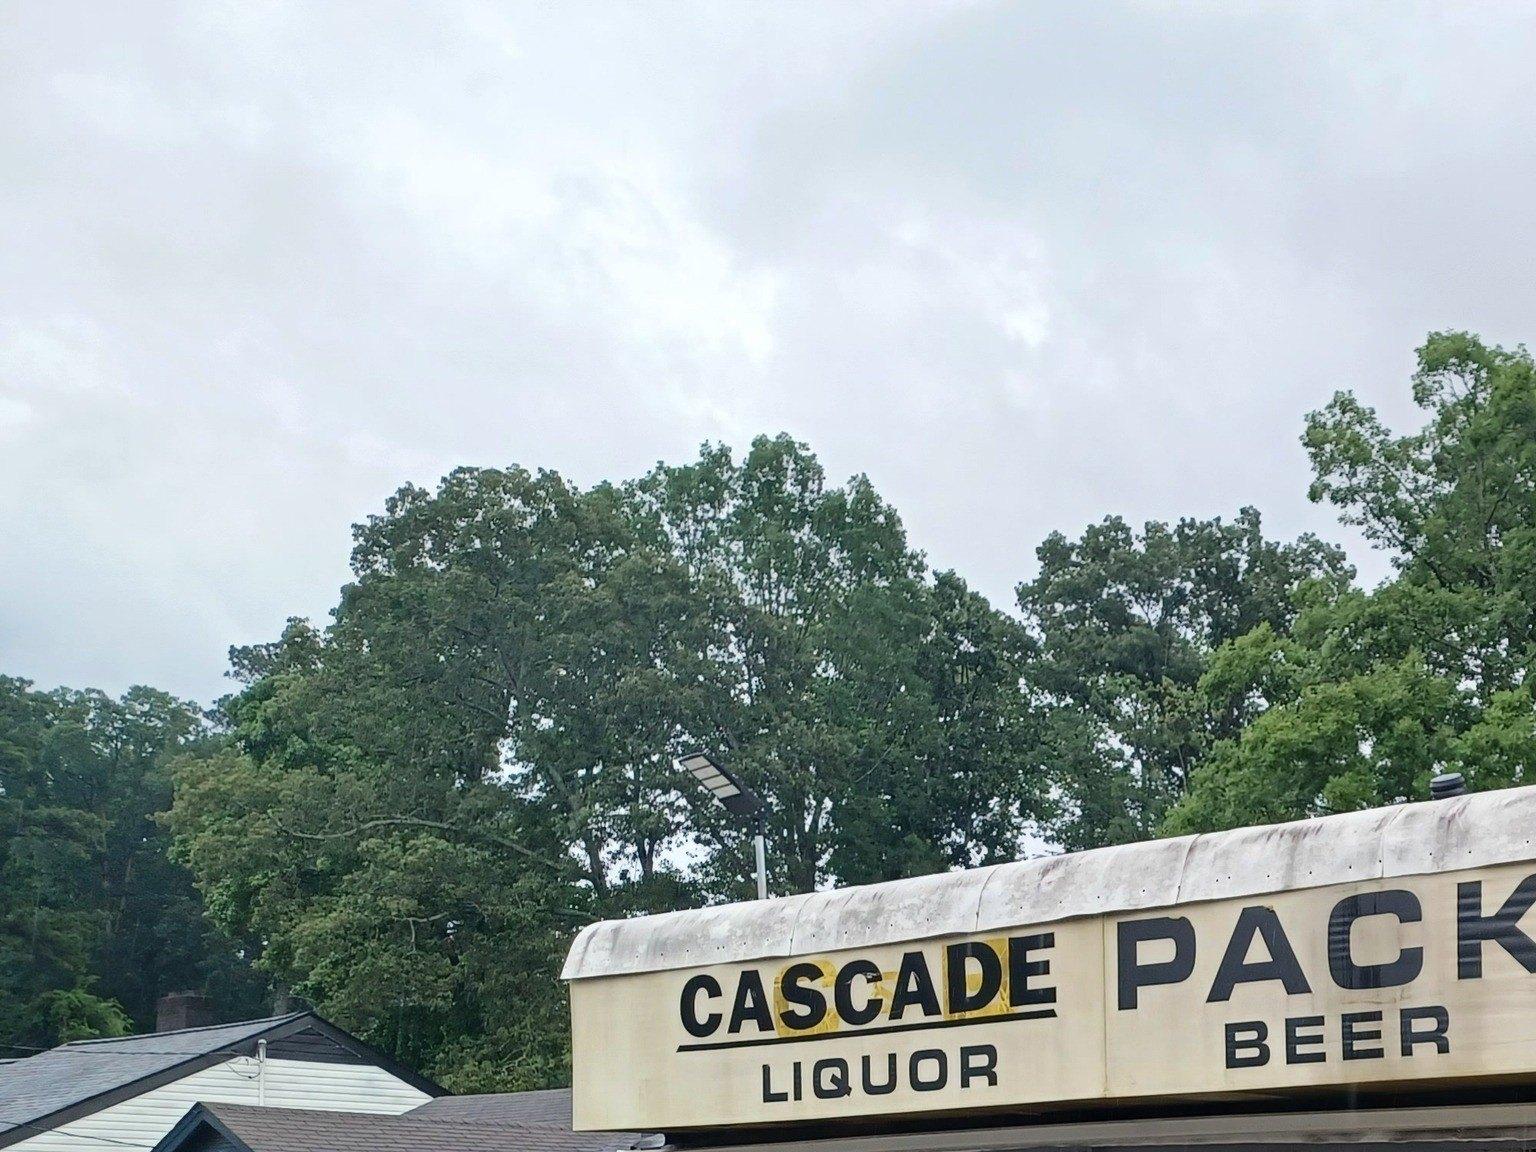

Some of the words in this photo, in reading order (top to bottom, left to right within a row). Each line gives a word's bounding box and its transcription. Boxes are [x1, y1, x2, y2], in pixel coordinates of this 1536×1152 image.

[678, 932, 1057, 1037] CASCADE
[1225, 1006, 1450, 1070] BEER
[762, 1043, 998, 1103] LIQUOR
